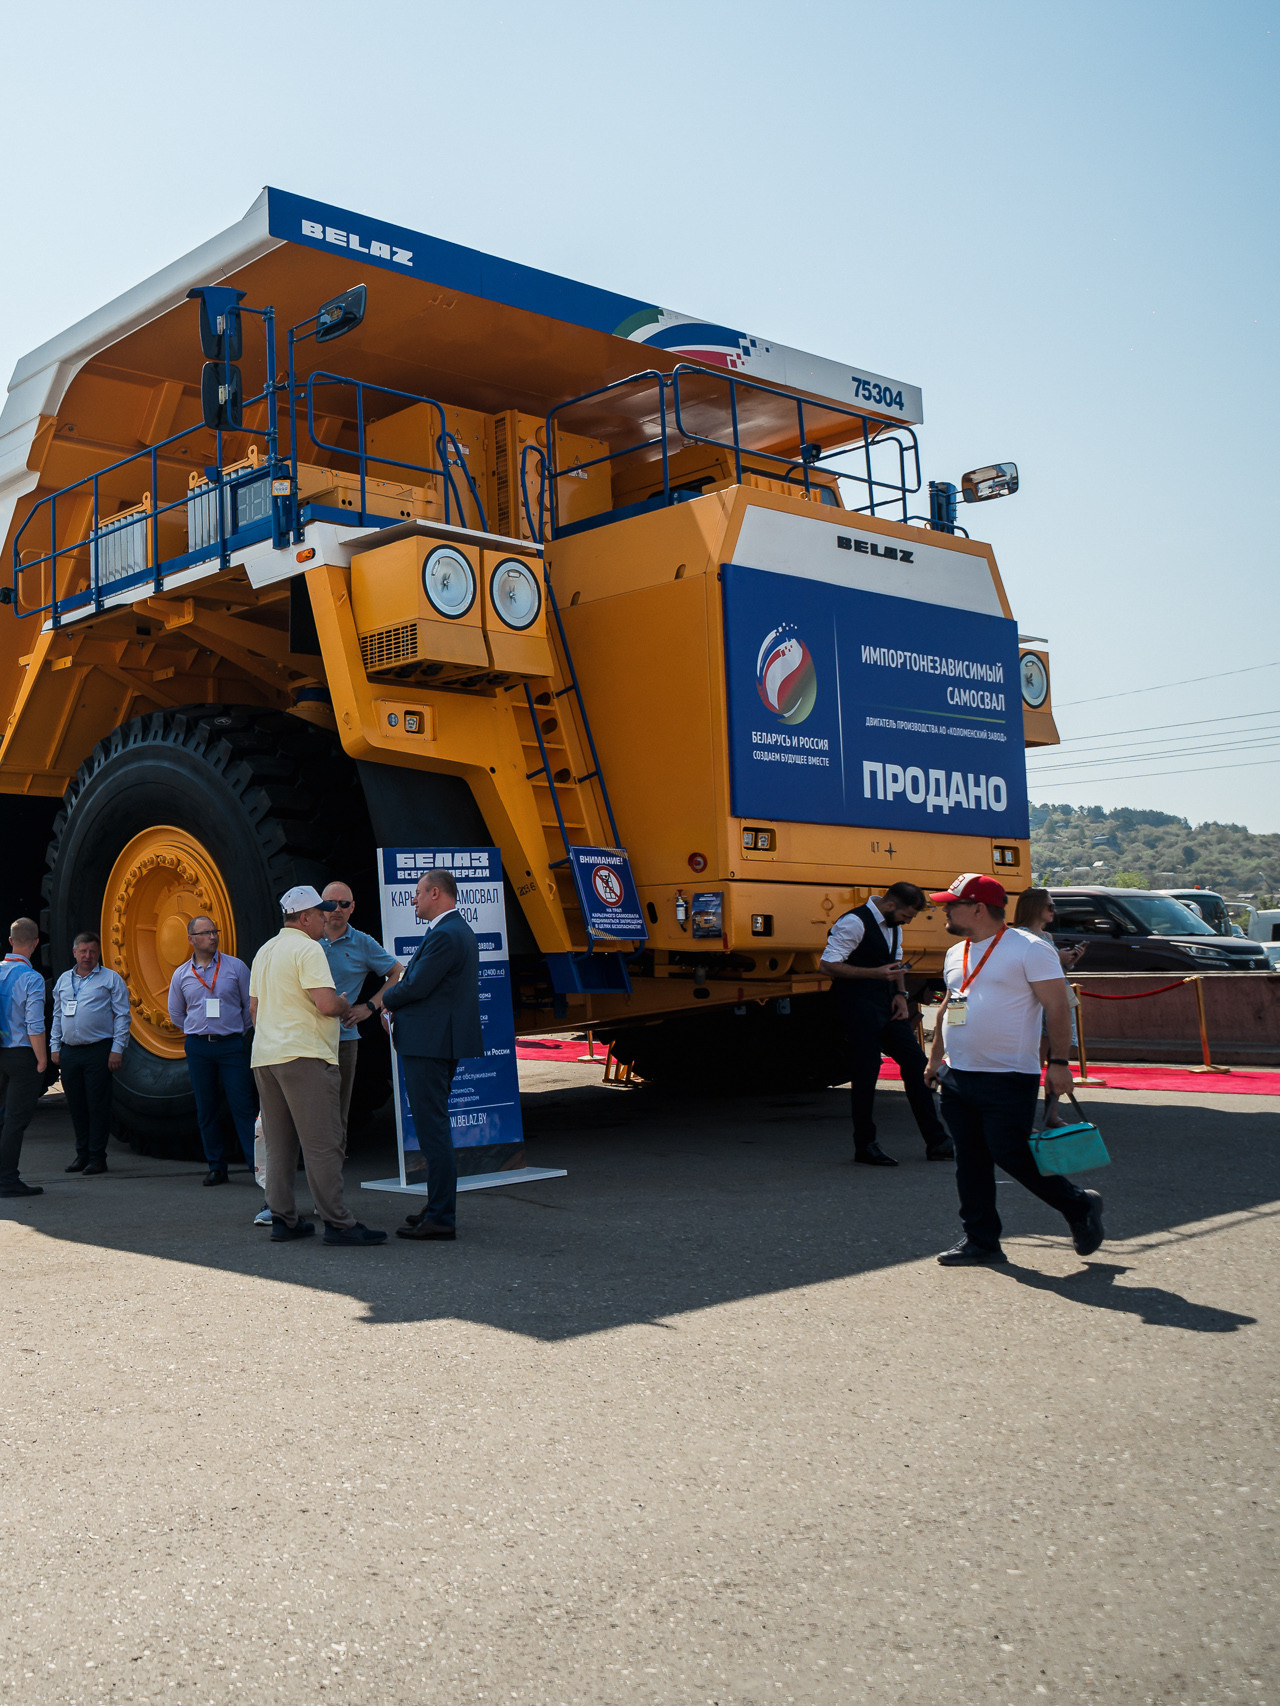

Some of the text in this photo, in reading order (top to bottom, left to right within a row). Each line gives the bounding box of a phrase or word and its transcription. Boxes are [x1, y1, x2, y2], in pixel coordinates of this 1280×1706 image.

[302, 219, 413, 266] BELAZ
[852, 376, 904, 411] 75304
[837, 536, 914, 564] BELAZ
[861, 644, 1004, 683] ИМПОРТОНЕЗАВИСИМЫЙ
[947, 686, 1005, 711] САМОСВАЛ
[865, 716, 1007, 742] ДВИГАТЕЛЬ ПРОИЗВОДСТВА АО «КОЛОМЕНСКИЙ ЗАВОД»
[752, 731, 829, 750] БЕЛАРУСЬ И РОССИЯ
[753, 750, 830, 767] СОЗДАЕМ БУДУЩЕЕ ВМЕСТЕ
[863, 760, 1007, 814] ПРОДАНО
[396, 853, 489, 868] БЕЛАЗ
[580, 855, 623, 865] ВНИМАНИЕ!
[397, 869, 490, 879] ВСЕГ ПЕРЕДИ
[456, 889, 499, 905] АМОСВАЛ
[450, 1112, 487, 1128] W.BELAZ.BY
